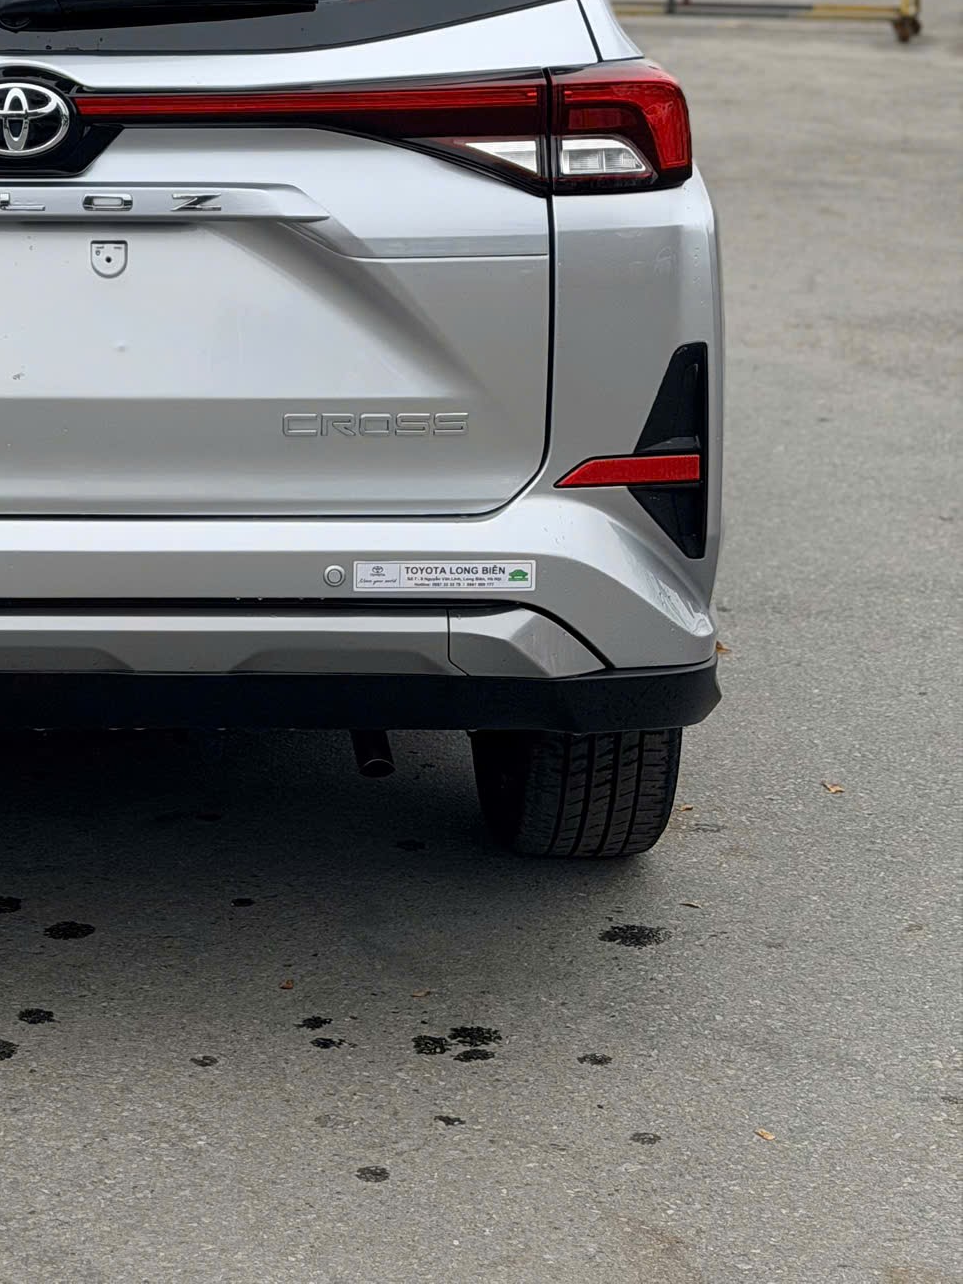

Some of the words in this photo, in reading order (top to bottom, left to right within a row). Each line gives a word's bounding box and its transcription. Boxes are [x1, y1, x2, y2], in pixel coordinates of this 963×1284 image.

[282, 412, 469, 436] CROSS
[405, 566, 446, 575] TOYOTA
[449, 566, 479, 575] LONG
[481, 564, 506, 575] BIÊN
